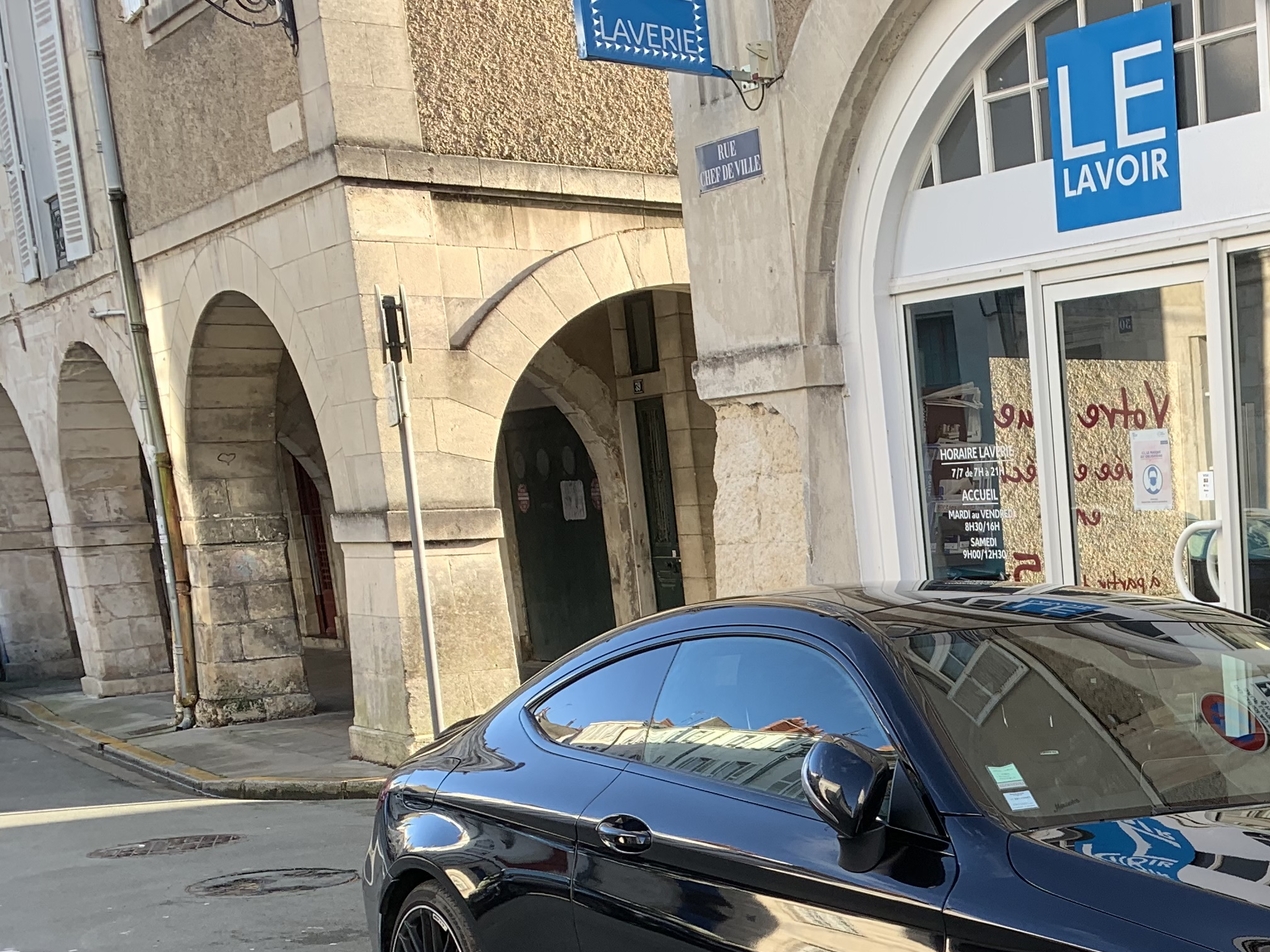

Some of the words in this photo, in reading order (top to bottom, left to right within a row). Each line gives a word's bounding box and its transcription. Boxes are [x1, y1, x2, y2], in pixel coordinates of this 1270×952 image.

[600, 15, 698, 54] LAVERIE
[1056, 39, 1167, 162] LE
[717, 140, 736, 160] RUE
[700, 166, 721, 187] CHEF
[722, 162, 734, 180] DE
[734, 154, 761, 176] VILLE
[1063, 147, 1169, 198] LAVOIR
[940, 447, 978, 460] HORAIRE
[965, 468, 973, 478] de
[974, 468, 984, 476] 7H
[990, 467, 1005, 476] 21H
[962, 489, 998, 502] ACCUEIL
[948, 510, 970, 519] MARDI
[972, 511, 979, 519] au
[964, 522, 1000, 532] 8H30/16H
[970, 538, 997, 547] SAMEDI
